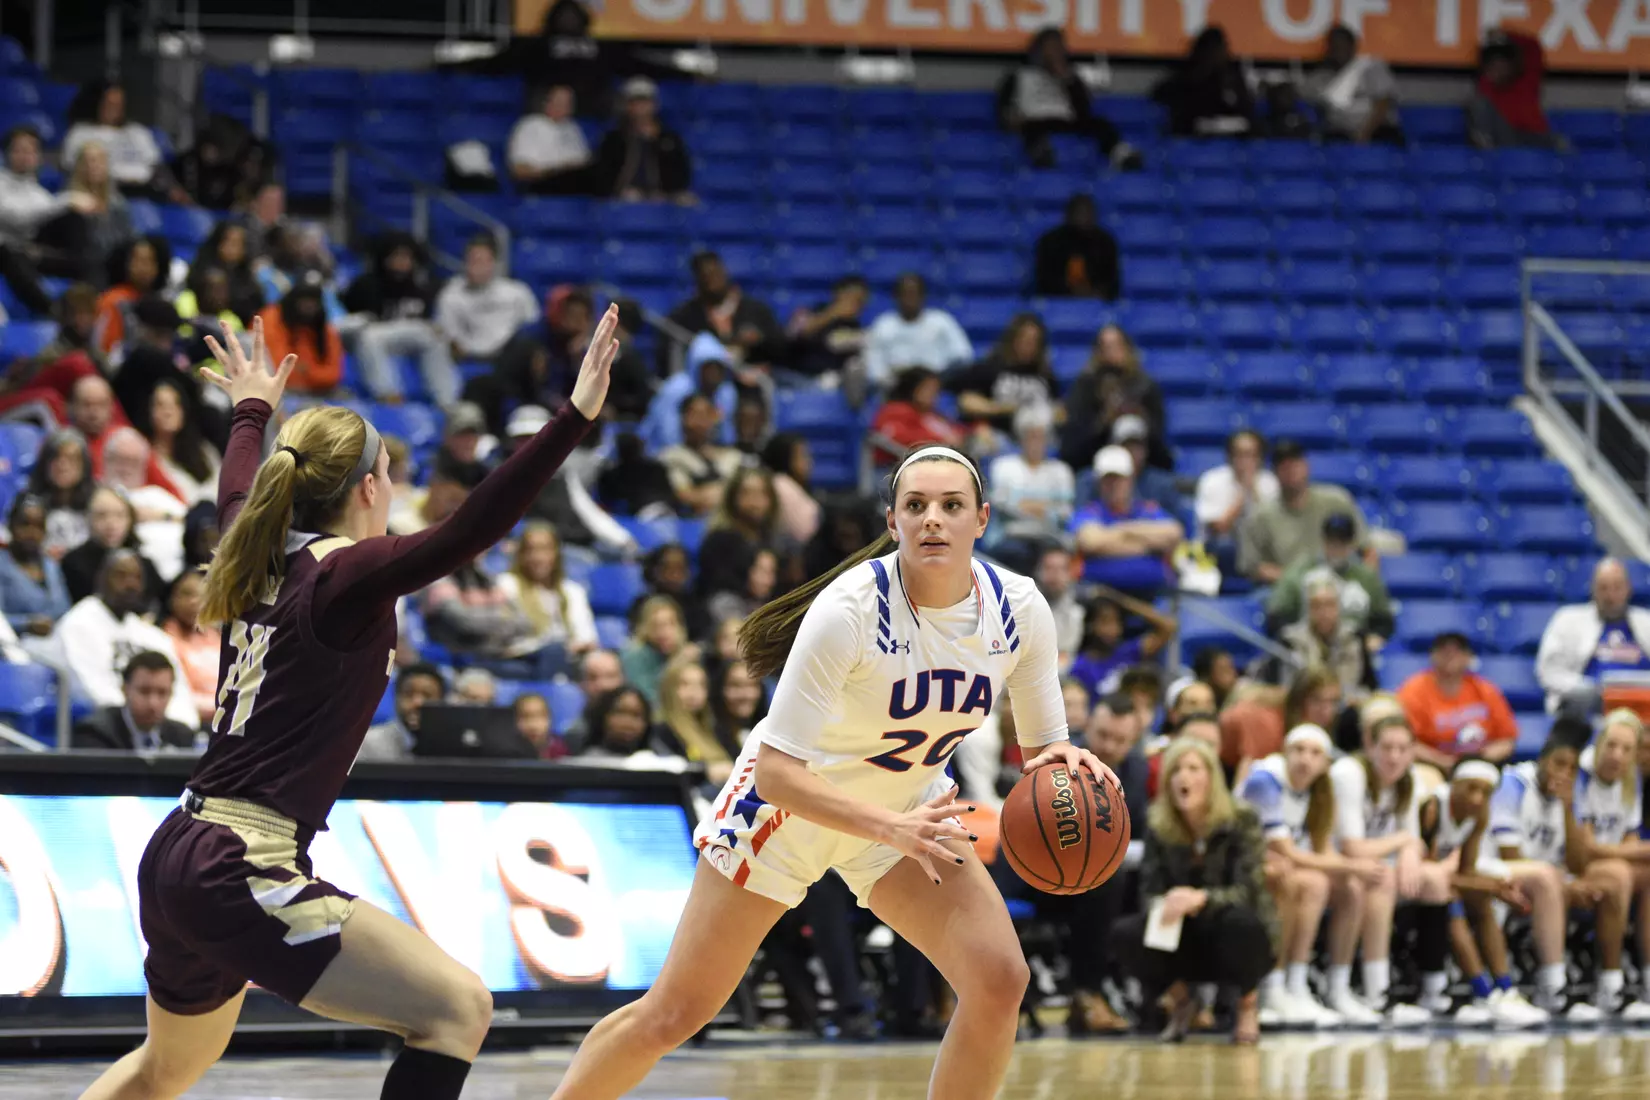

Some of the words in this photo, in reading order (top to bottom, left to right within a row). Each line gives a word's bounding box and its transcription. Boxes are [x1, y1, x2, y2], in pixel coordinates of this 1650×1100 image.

[888, 668, 993, 721] UTA
[863, 727, 980, 773] 20
[1050, 767, 1082, 850] Wilson
